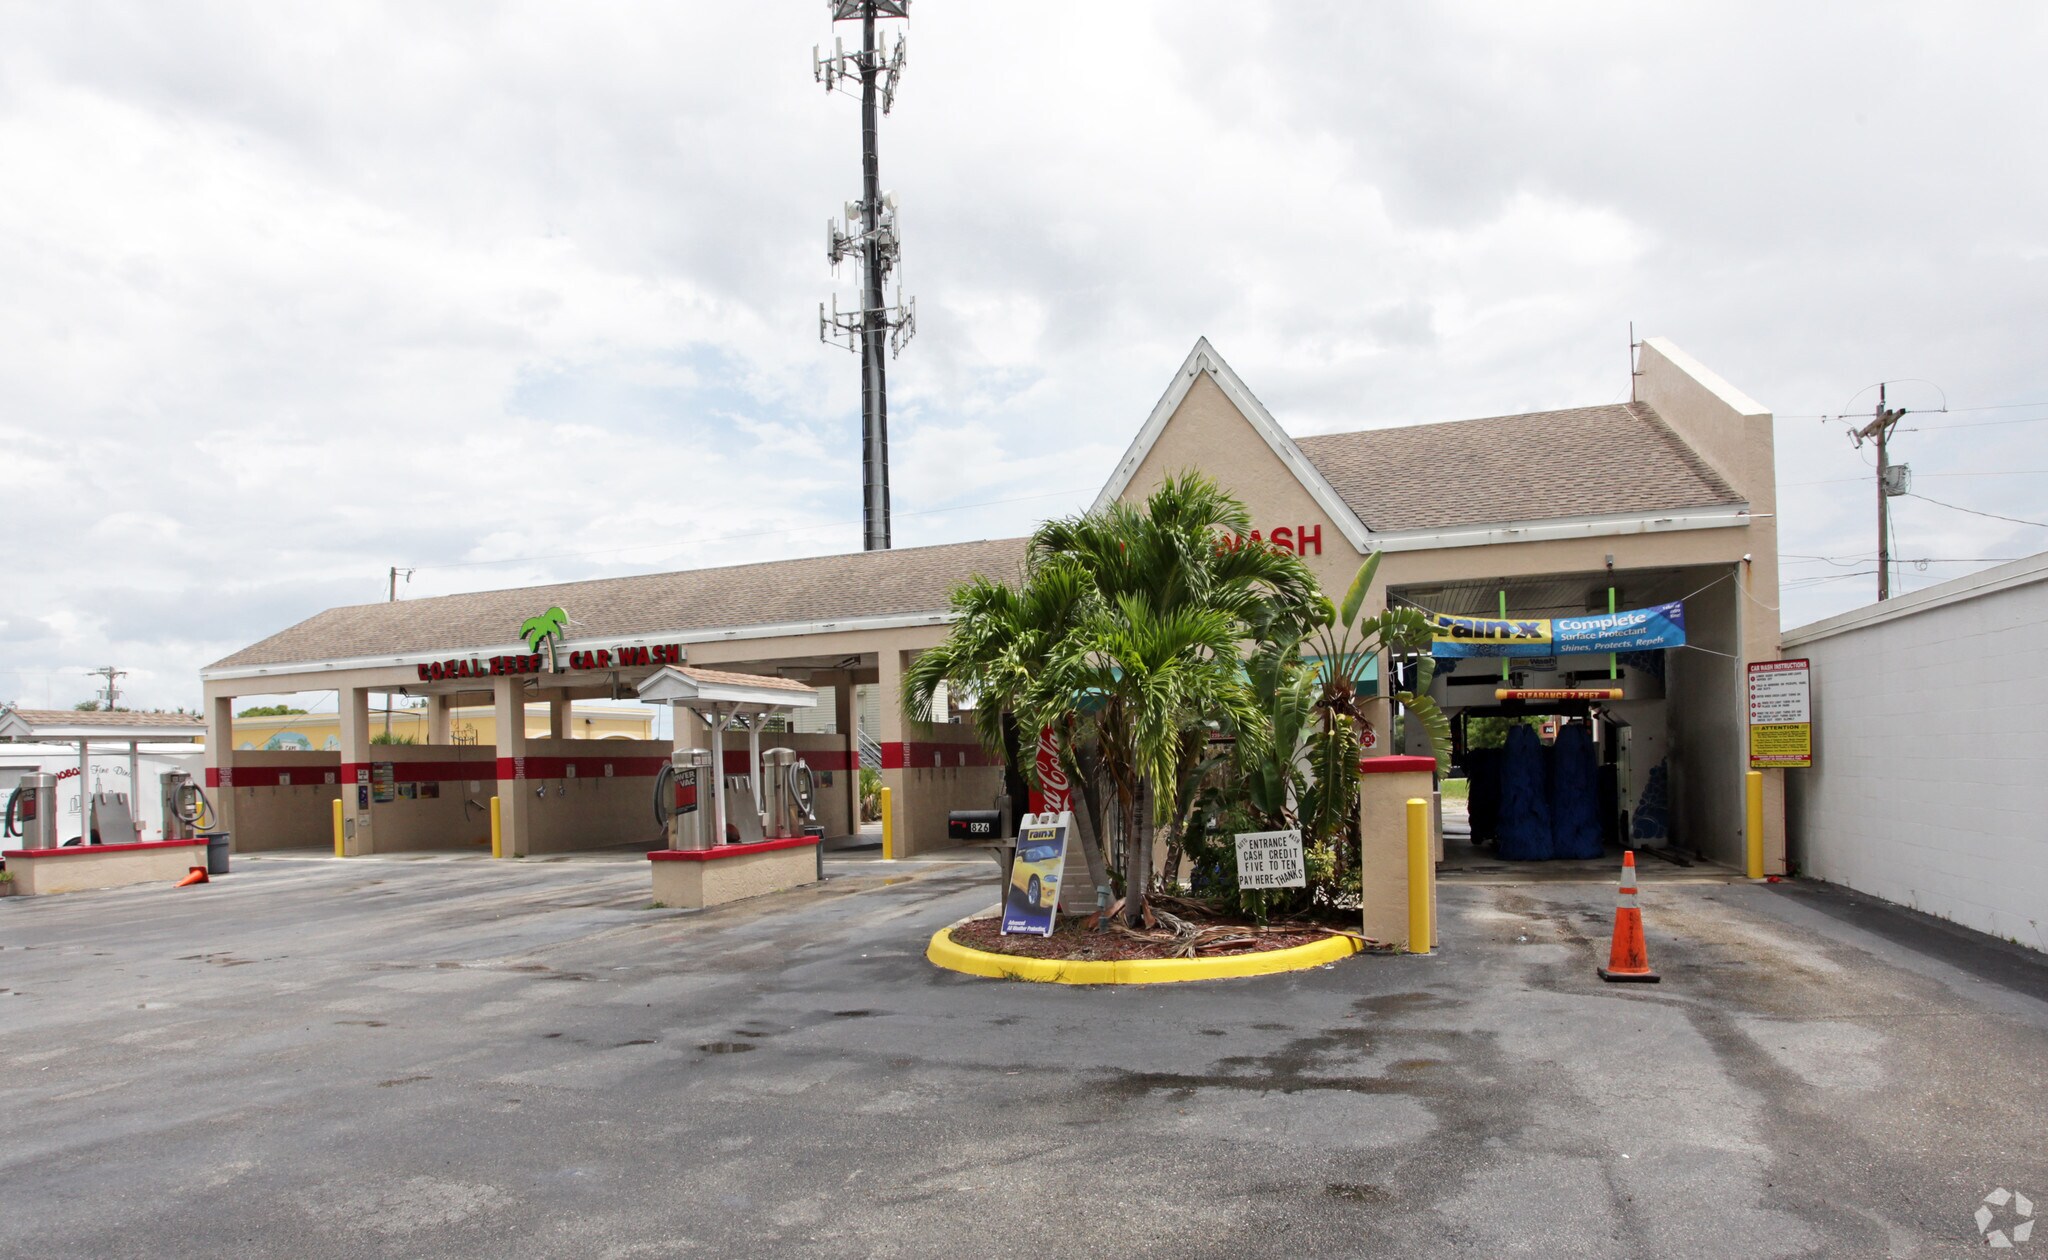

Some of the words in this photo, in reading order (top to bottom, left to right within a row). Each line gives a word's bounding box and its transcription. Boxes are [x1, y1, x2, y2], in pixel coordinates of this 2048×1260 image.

[1559, 613, 1646, 631] Complete
[1560, 631, 1596, 641] Surface
[1598, 627, 1647, 638] Protectant
[1560, 644, 1591, 652] Shines,
[1594, 640, 1633, 650] Protects,
[1636, 636, 1665, 647] Repels
[418, 658, 488, 682] CORAL
[488, 653, 542, 675] REEF
[569, 649, 614, 669] CAR
[618, 643, 682, 667] WASH
[1774, 661, 1807, 670] INSTRUCTIONS
[91, 764, 110, 774] Fine
[674, 770, 695, 783] OWER
[680, 777, 695, 787] VAC
[971, 823, 989, 832] 826
[1237, 838, 1248, 850] AUTO
[1249, 837, 1288, 849] ENTRANCE
[1289, 833, 1300, 844] WASH
[1243, 850, 1263, 861] CASH
[1269, 848, 1298, 860] CREDIT
[1245, 862, 1264, 872] FIVE
[1269, 861, 1279, 871] TO
[1281, 860, 1297, 870] TEN
[1240, 876, 1253, 885] PAY
[1255, 874, 1274, 885] HERE
[1275, 868, 1303, 886] THANKS
